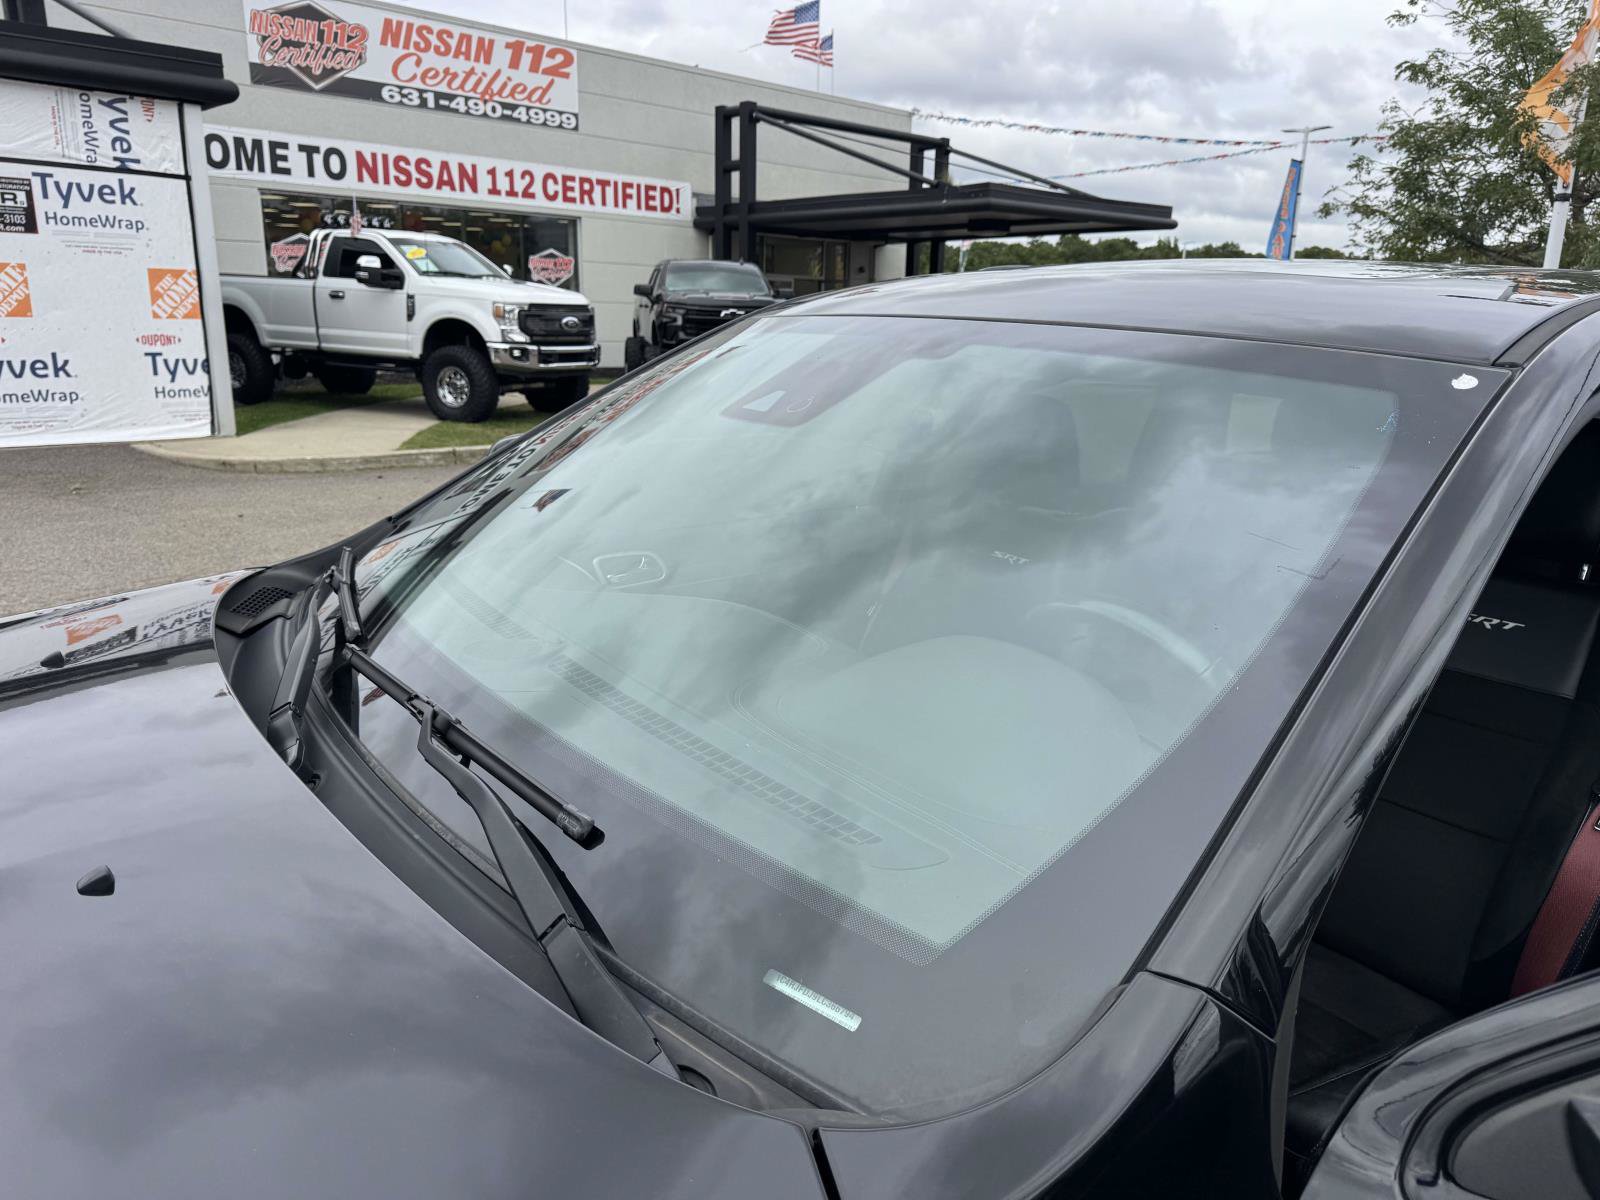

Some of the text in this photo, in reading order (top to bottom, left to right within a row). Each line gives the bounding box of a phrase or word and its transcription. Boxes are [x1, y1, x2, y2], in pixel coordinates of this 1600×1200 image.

[250, 9, 368, 49] NISSAN 112
[379, 17, 575, 79] NISSAN 112
[258, 35, 367, 75] Certified
[391, 53, 555, 105] Certified
[381, 85, 577, 129] 631-490-4999
[97, 95, 141, 170] yvek
[31, 171, 139, 209] Tyvek
[204, 133, 681, 214] OME TO NISSAN 112 CERTIFIED!
[44, 211, 145, 233] HomeWrap
[141, 333, 176, 346] DUPONT
[0, 389, 79, 404] meWrap
